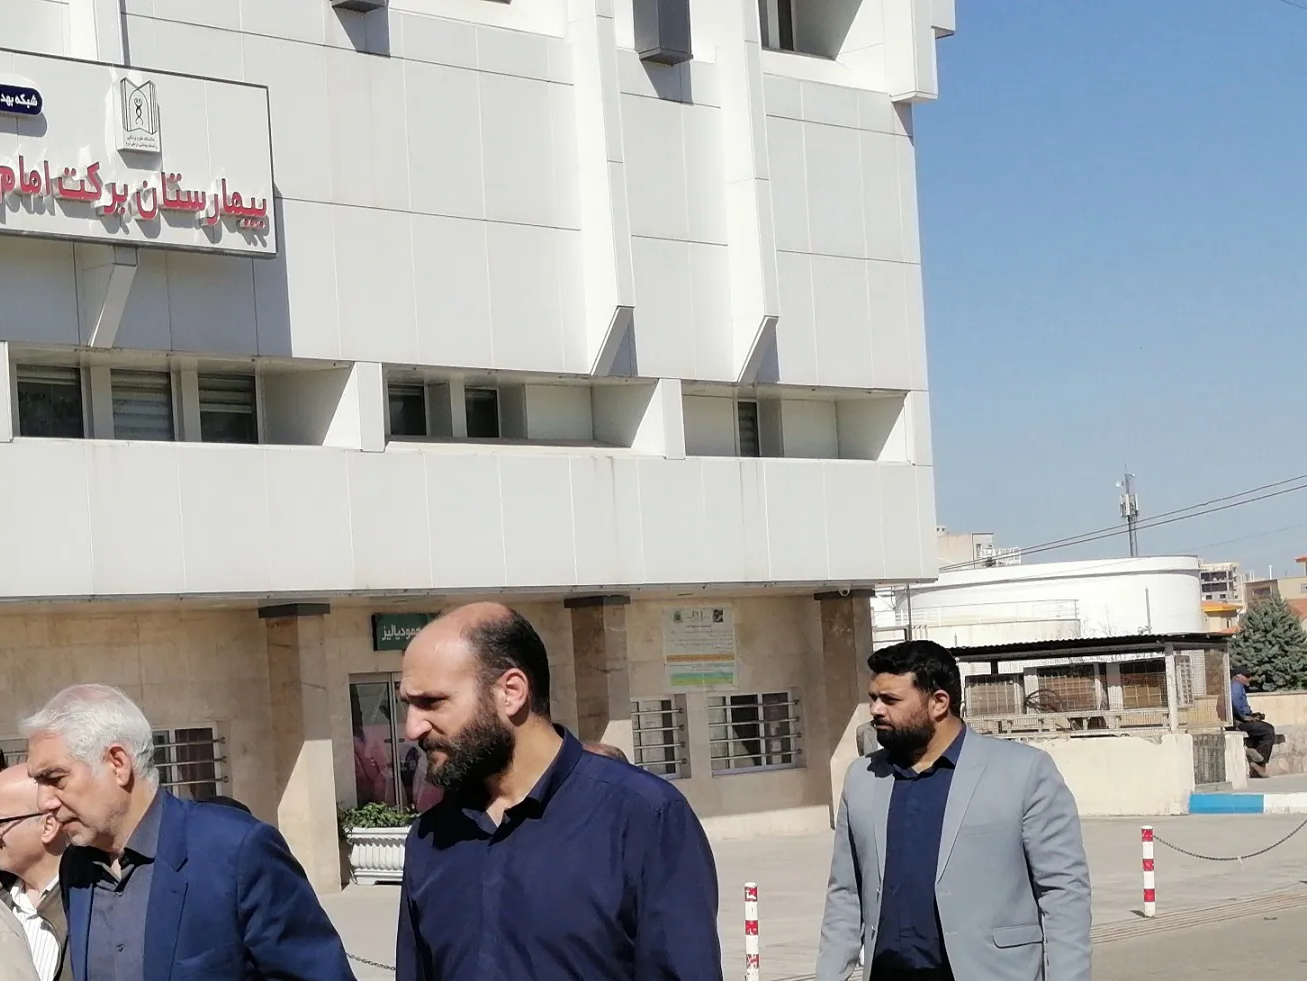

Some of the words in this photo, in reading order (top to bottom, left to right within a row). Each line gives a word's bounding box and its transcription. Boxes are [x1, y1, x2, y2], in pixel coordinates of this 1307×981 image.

[16, 94, 38, 108] شبکه
[59, 161, 128, 215] برکت
[136, 171, 267, 229] بیمارستان
